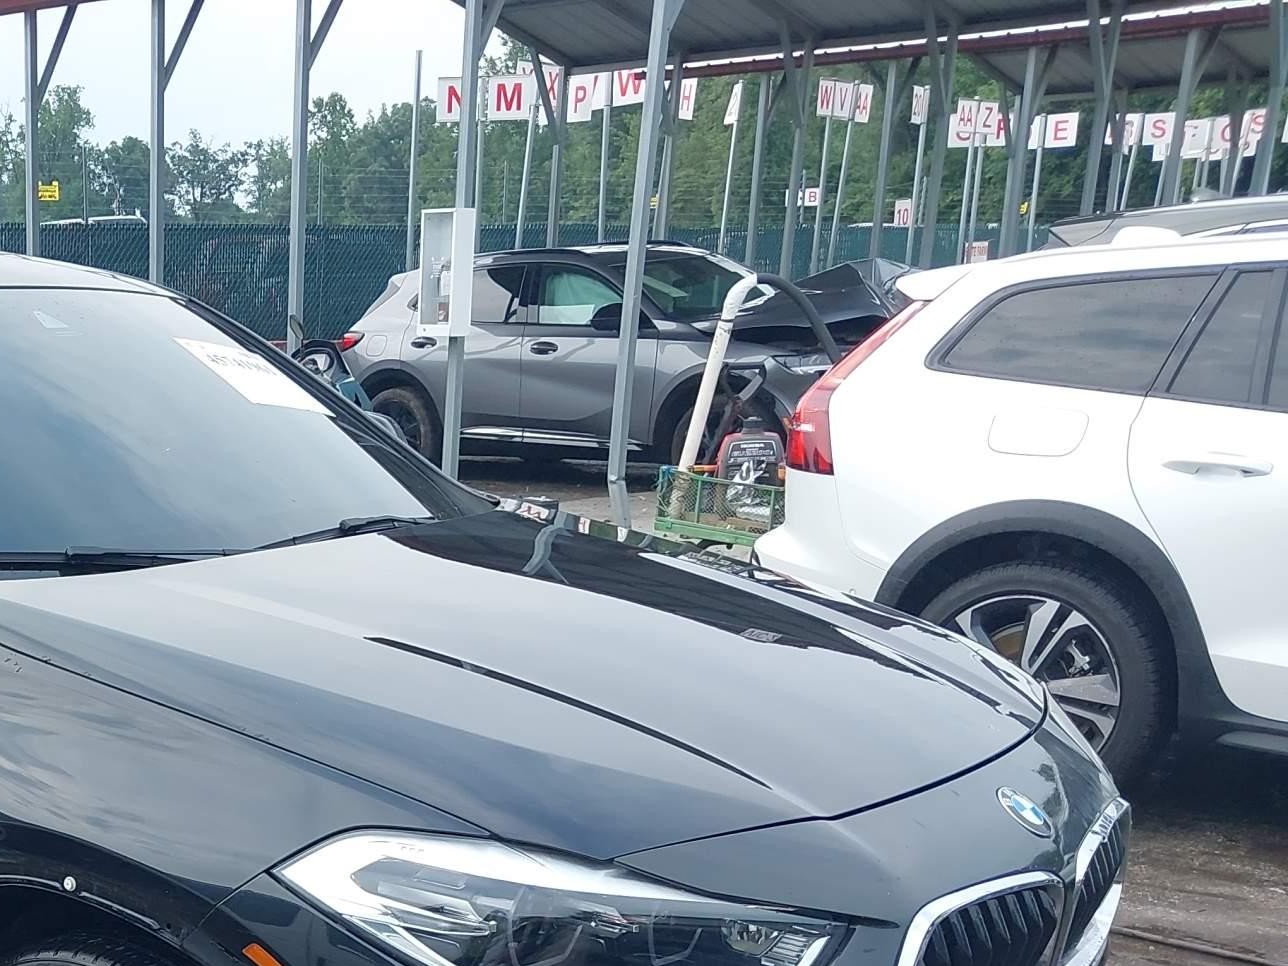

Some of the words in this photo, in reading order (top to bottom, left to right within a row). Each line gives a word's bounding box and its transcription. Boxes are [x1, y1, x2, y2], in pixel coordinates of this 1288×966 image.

[496, 82, 522, 112] M
[574, 85, 587, 114] P
[680, 83, 693, 112] H
[820, 85, 833, 110] W
[839, 87, 849, 111] V
[958, 104, 973, 128] AA
[982, 106, 994, 129] Z
[1053, 119, 1070, 142] E
[1150, 118, 1167, 139] S
[808, 191, 817, 203] B
[896, 207, 909, 226] 10
